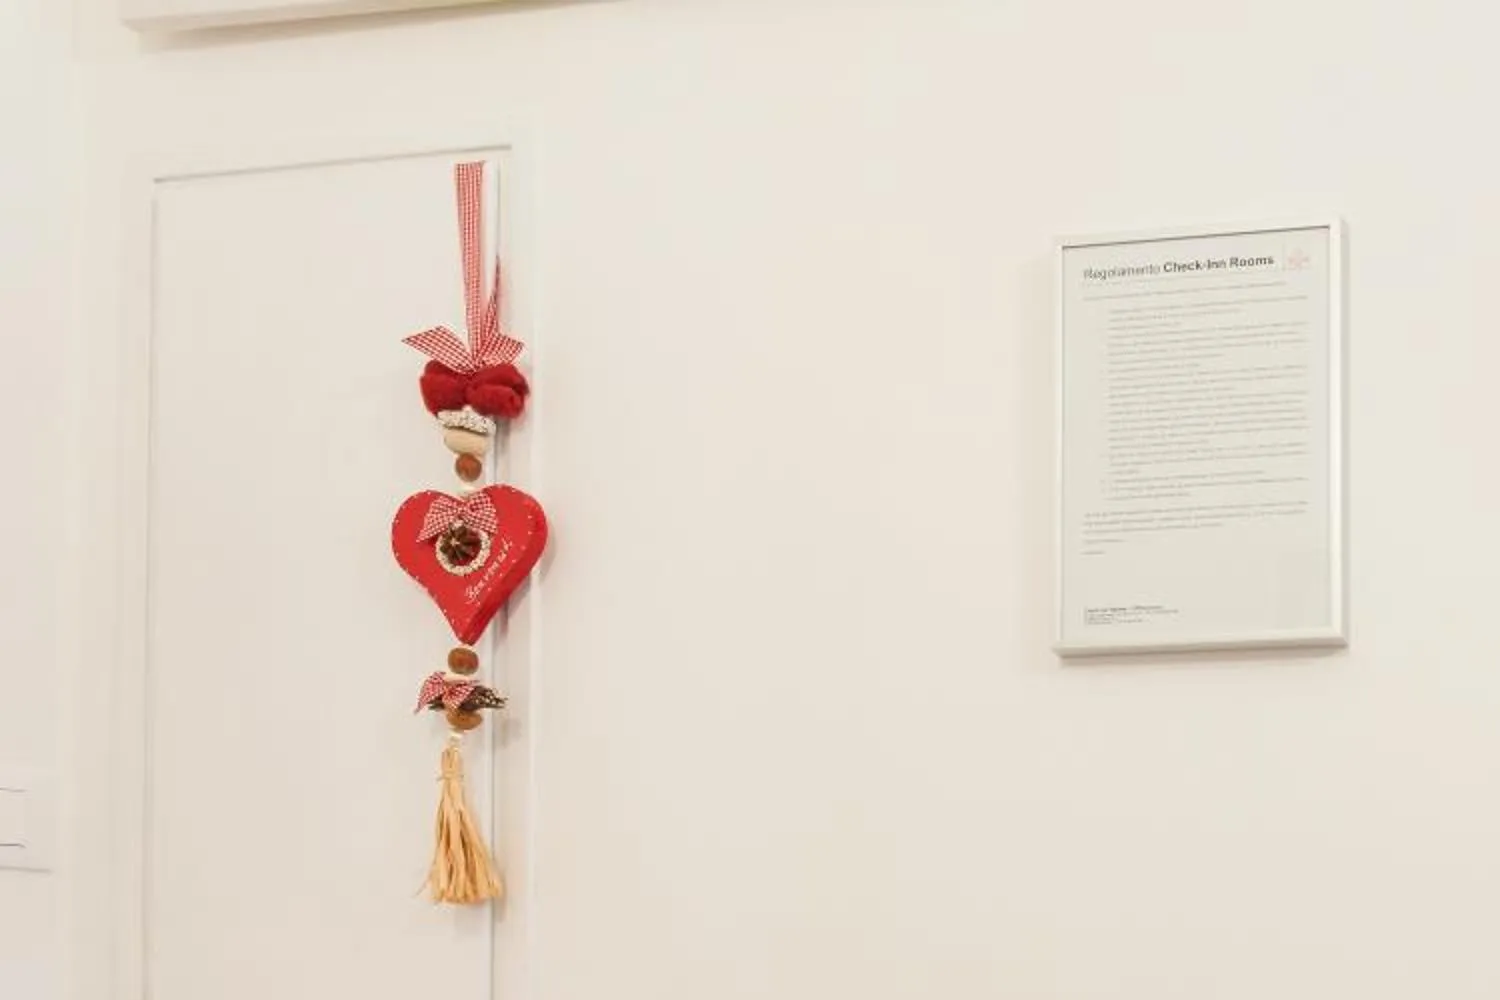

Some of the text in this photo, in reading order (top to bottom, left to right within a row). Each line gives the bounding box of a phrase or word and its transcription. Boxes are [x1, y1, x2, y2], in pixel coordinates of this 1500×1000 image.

[1083, 256, 1275, 281] Regolamento Check-Inn Rooms
